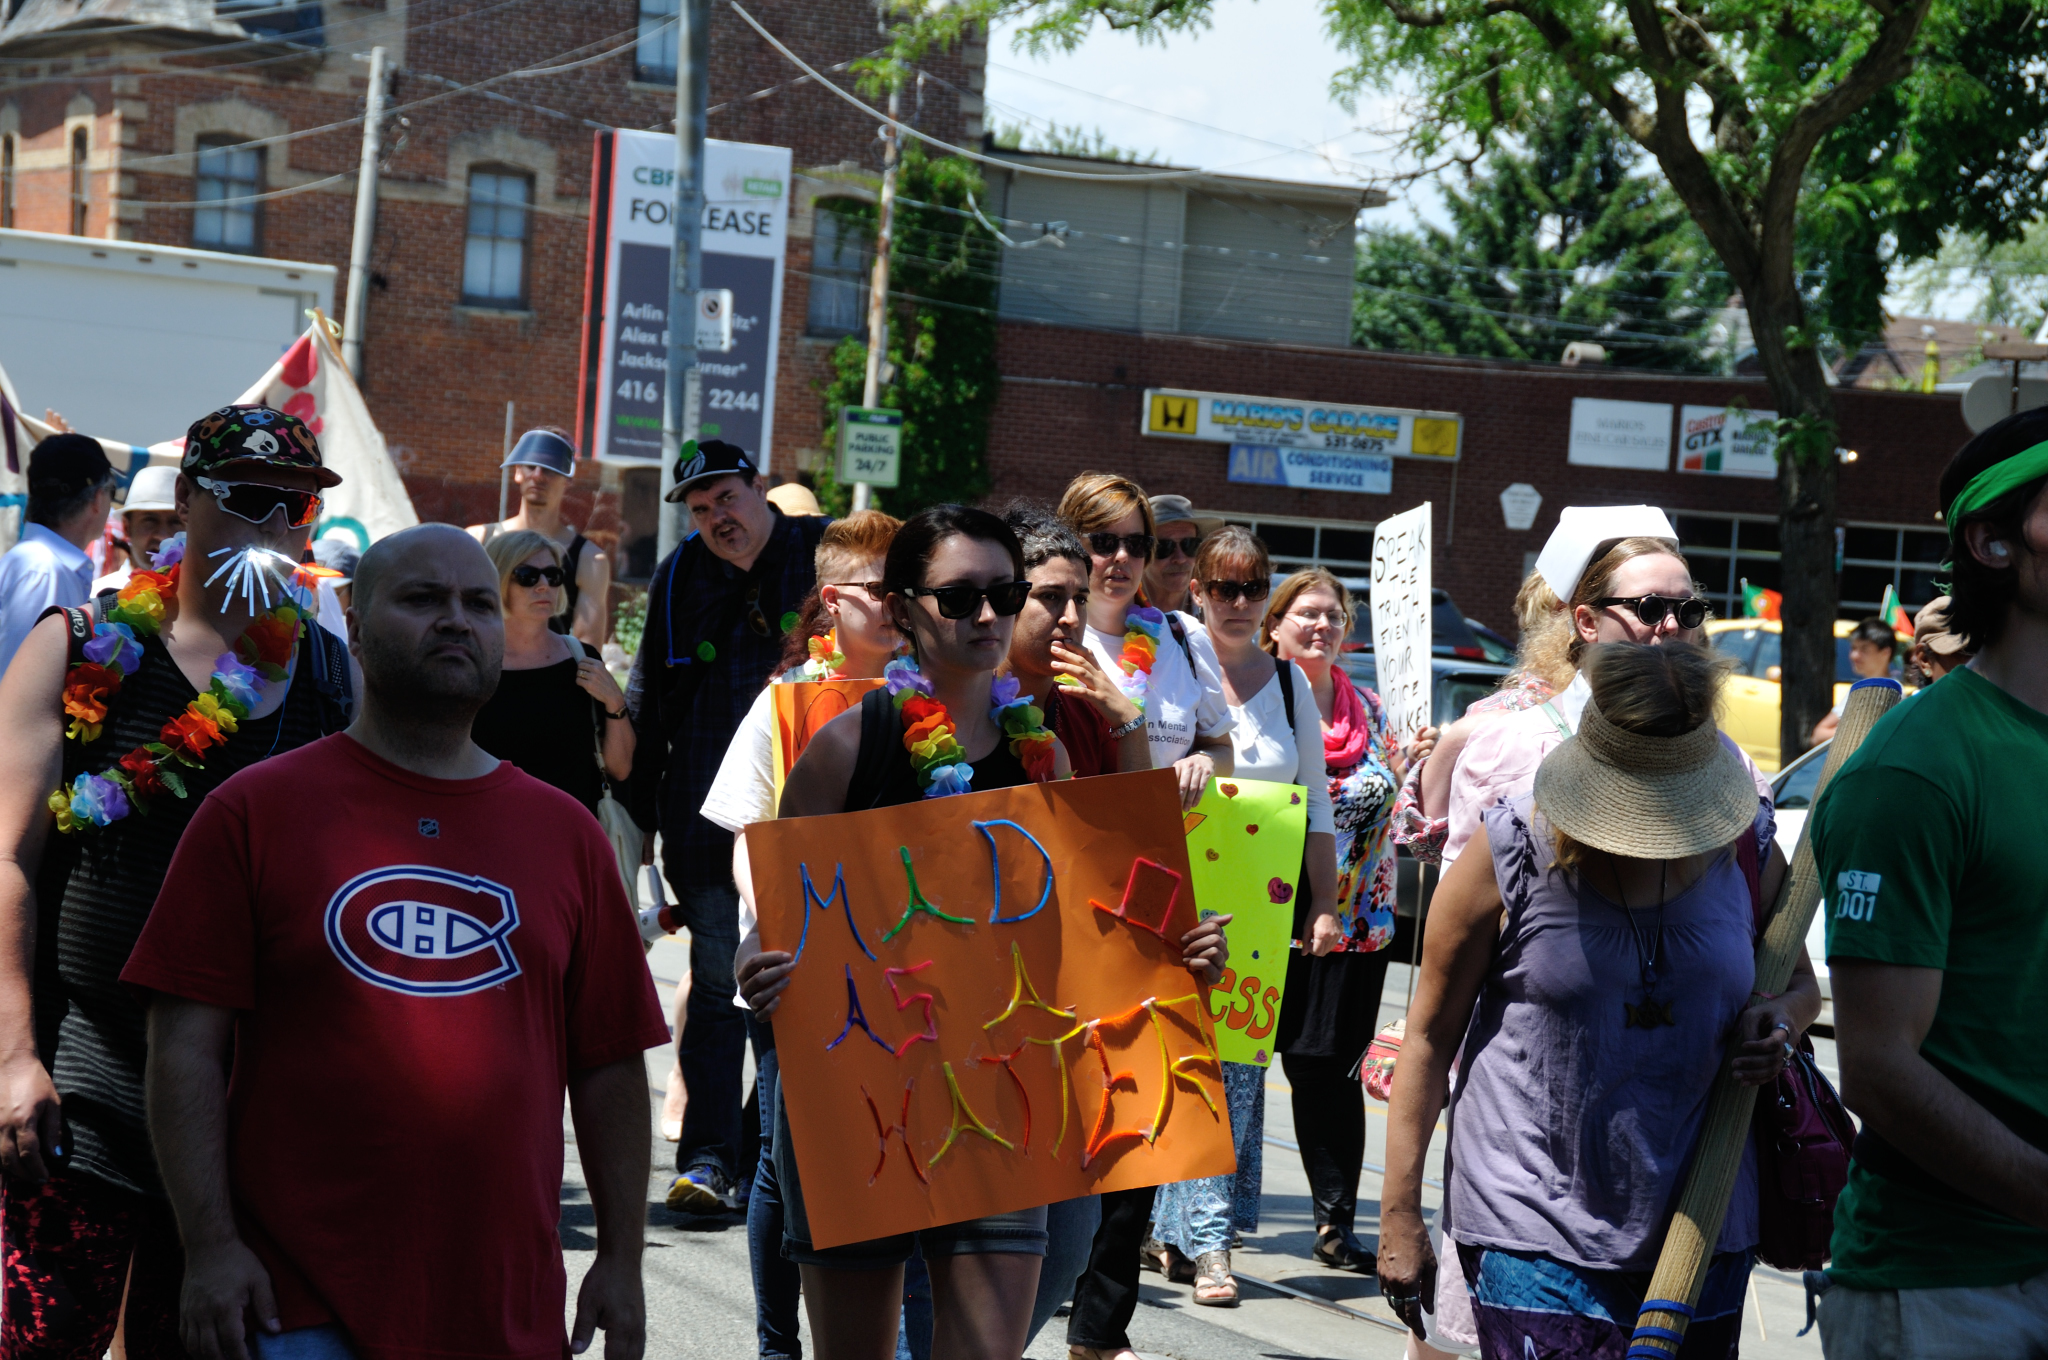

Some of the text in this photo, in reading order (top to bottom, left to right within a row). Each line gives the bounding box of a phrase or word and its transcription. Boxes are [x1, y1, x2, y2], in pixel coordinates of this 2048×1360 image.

[630, 197, 772, 236] FO EASE
[621, 302, 664, 321] Arlin
[620, 326, 658, 346] Alex
[696, 359, 747, 377] urner
[616, 379, 658, 403] 416
[708, 388, 760, 412] 2244
[1211, 399, 1305, 431] MARIO'S
[1309, 408, 1400, 440] GARAGE
[848, 442, 895, 456] PARKING
[855, 432, 890, 443] PUBLIC
[1325, 434, 1385, 451] 531-0875
[1686, 427, 1722, 450] GTX
[855, 458, 887, 473] 24/7
[1231, 447, 1389, 480] AIR CONDITIONING
[1309, 470, 1364, 487] SERVICE
[1375, 523, 1426, 583] SPEAK
[1389, 565, 1417, 592] THE
[1378, 588, 1420, 625] TRUTH
[1380, 612, 1426, 648] EVEN IF
[1382, 645, 1414, 685] YOUR
[1383, 680, 1419, 712] VOICE
[1157, 720, 1188, 732] Mental
[1391, 700, 1429, 740] HAKES
[1148, 734, 1191, 746] ssociation
[793, 818, 1054, 963] MAD
[1847, 871, 1868, 890] ST.
[1835, 889, 1877, 922] 001
[826, 959, 938, 1058] AS
[859, 993, 1219, 1186] HATTER
